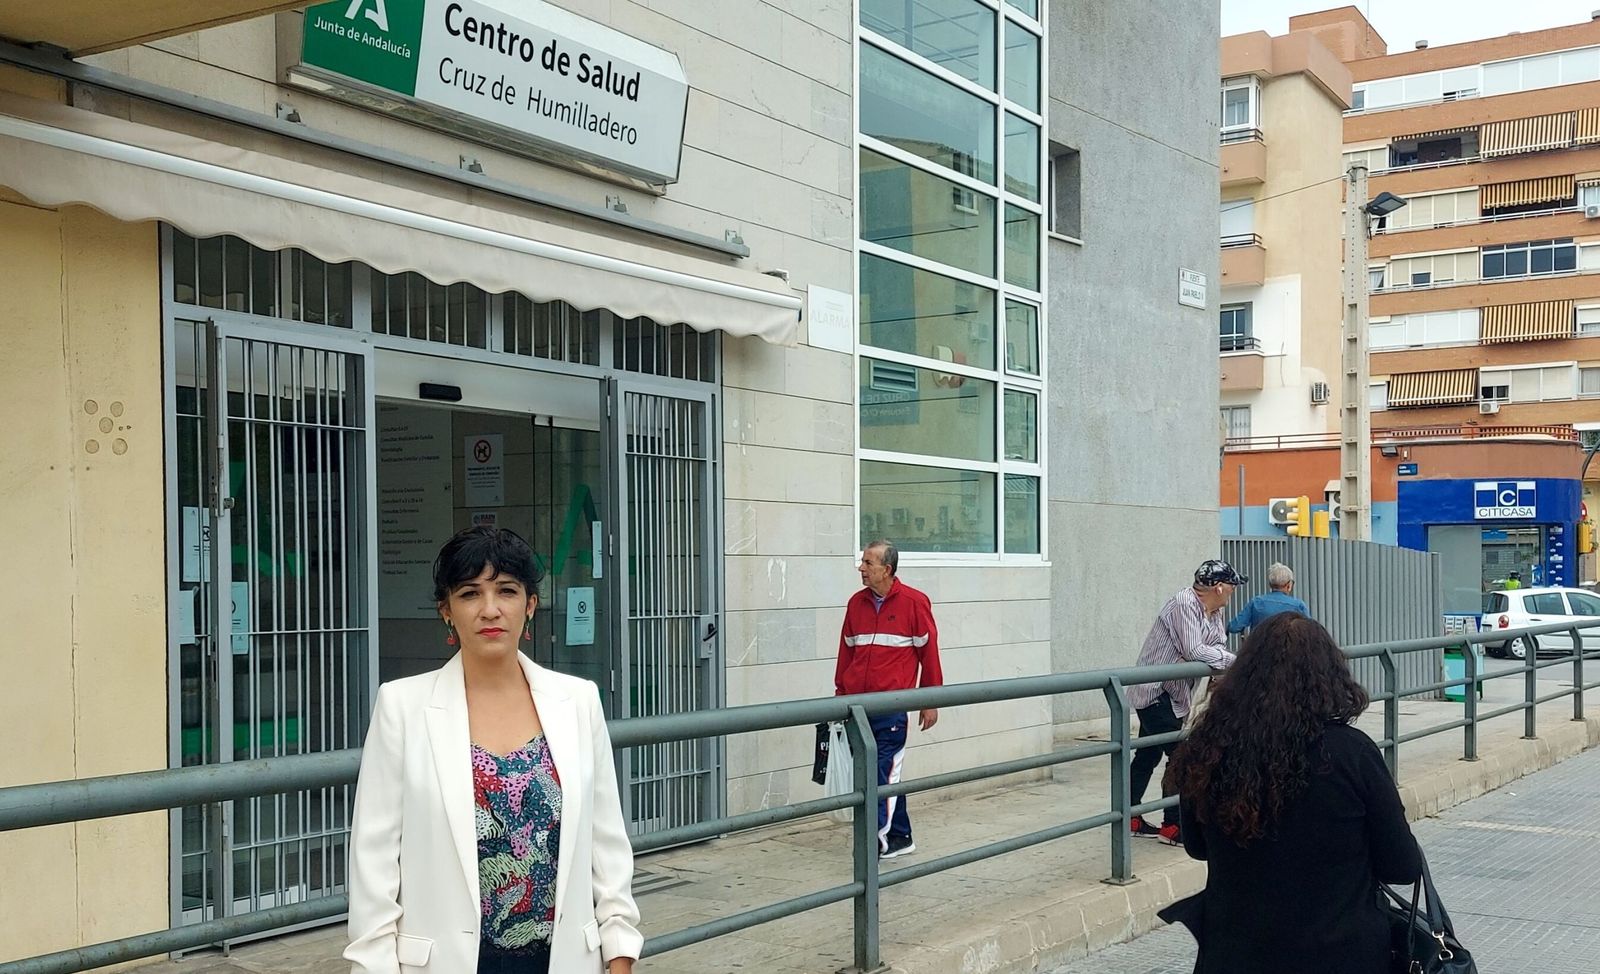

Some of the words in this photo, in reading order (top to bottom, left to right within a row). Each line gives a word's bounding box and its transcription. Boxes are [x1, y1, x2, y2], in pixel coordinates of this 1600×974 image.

[313, 16, 345, 36] Junta
[347, 26, 360, 42] de
[361, 32, 411, 58] Andalucía
[444, 2, 535, 63] Centro
[541, 39, 571, 76] de
[576, 53, 641, 102] Salud
[438, 57, 487, 97] Cruz
[490, 75, 517, 106] de
[527, 86, 638, 145] Humilladero
[1478, 507, 1534, 518] CITICASA
